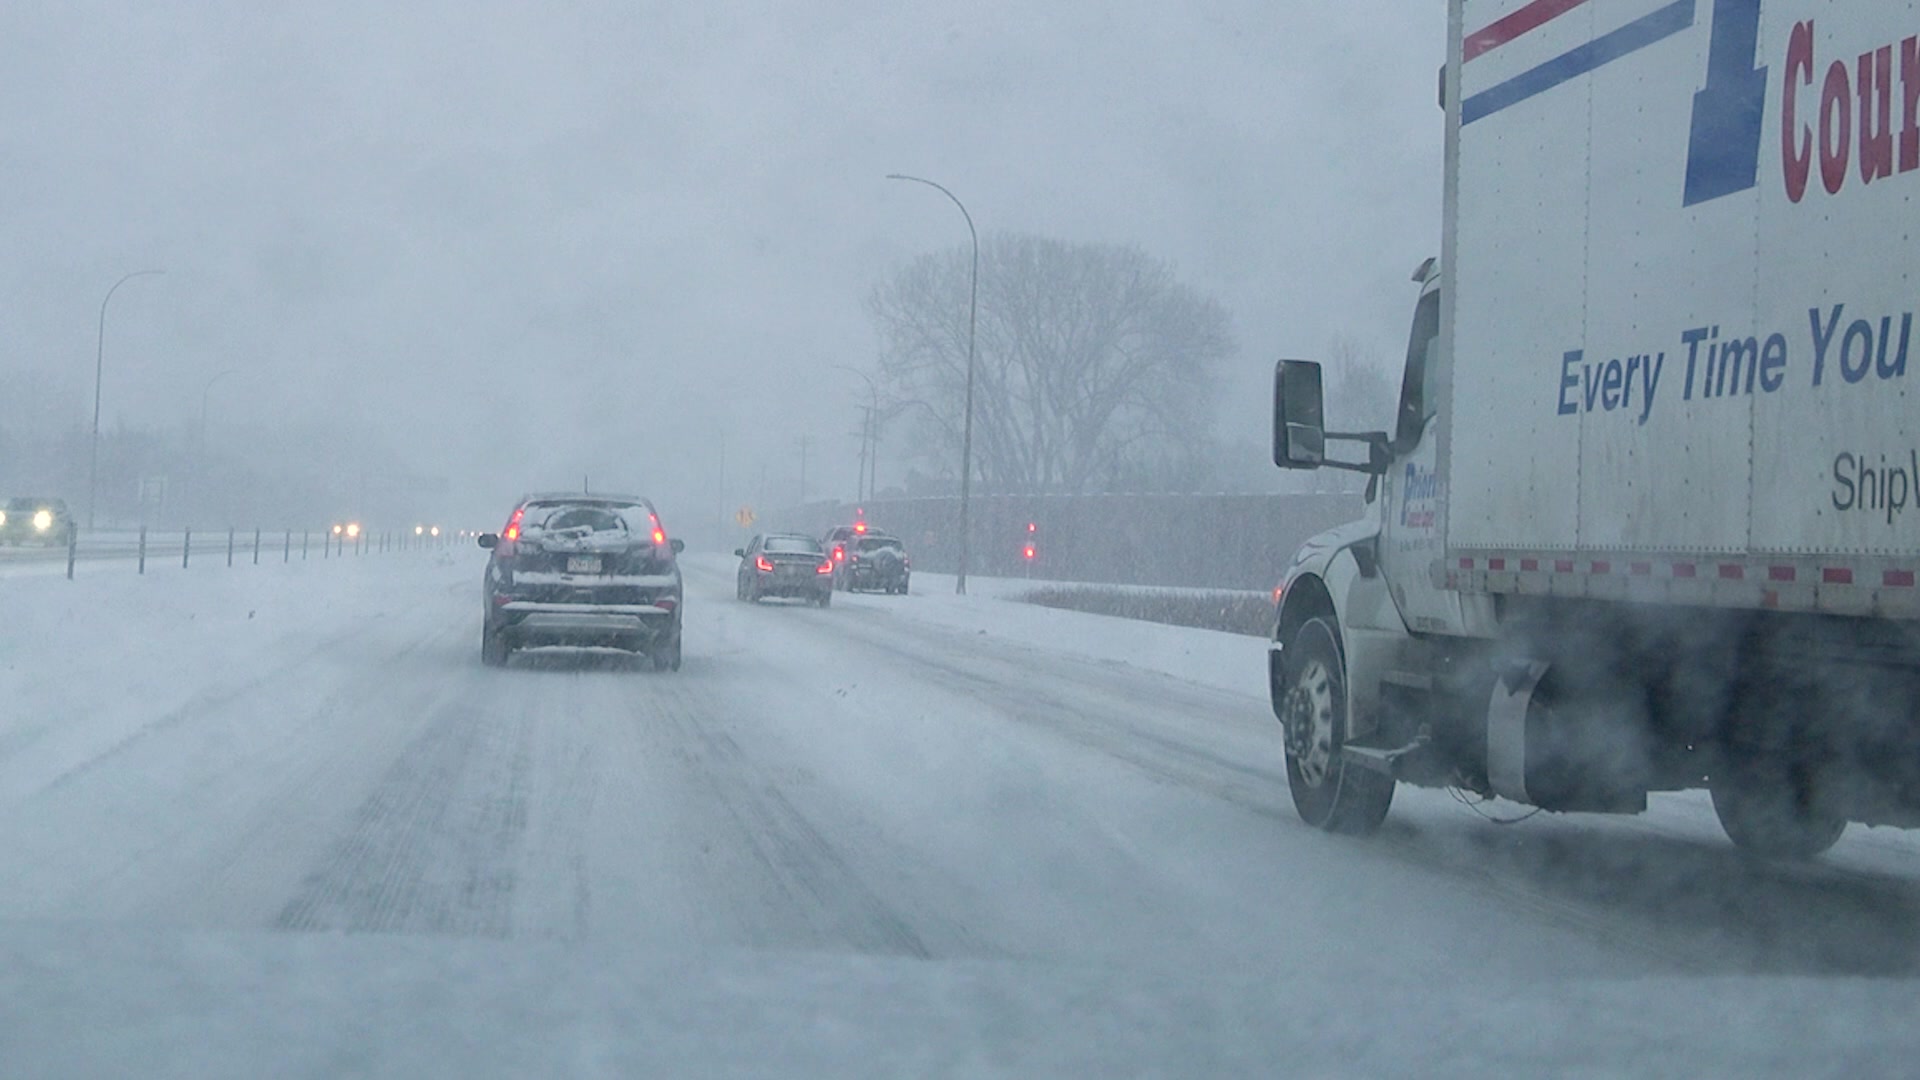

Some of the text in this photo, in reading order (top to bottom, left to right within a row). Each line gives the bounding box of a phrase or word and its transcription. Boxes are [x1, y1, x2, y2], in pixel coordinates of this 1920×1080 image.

[1557, 303, 1912, 427] Every Time You
